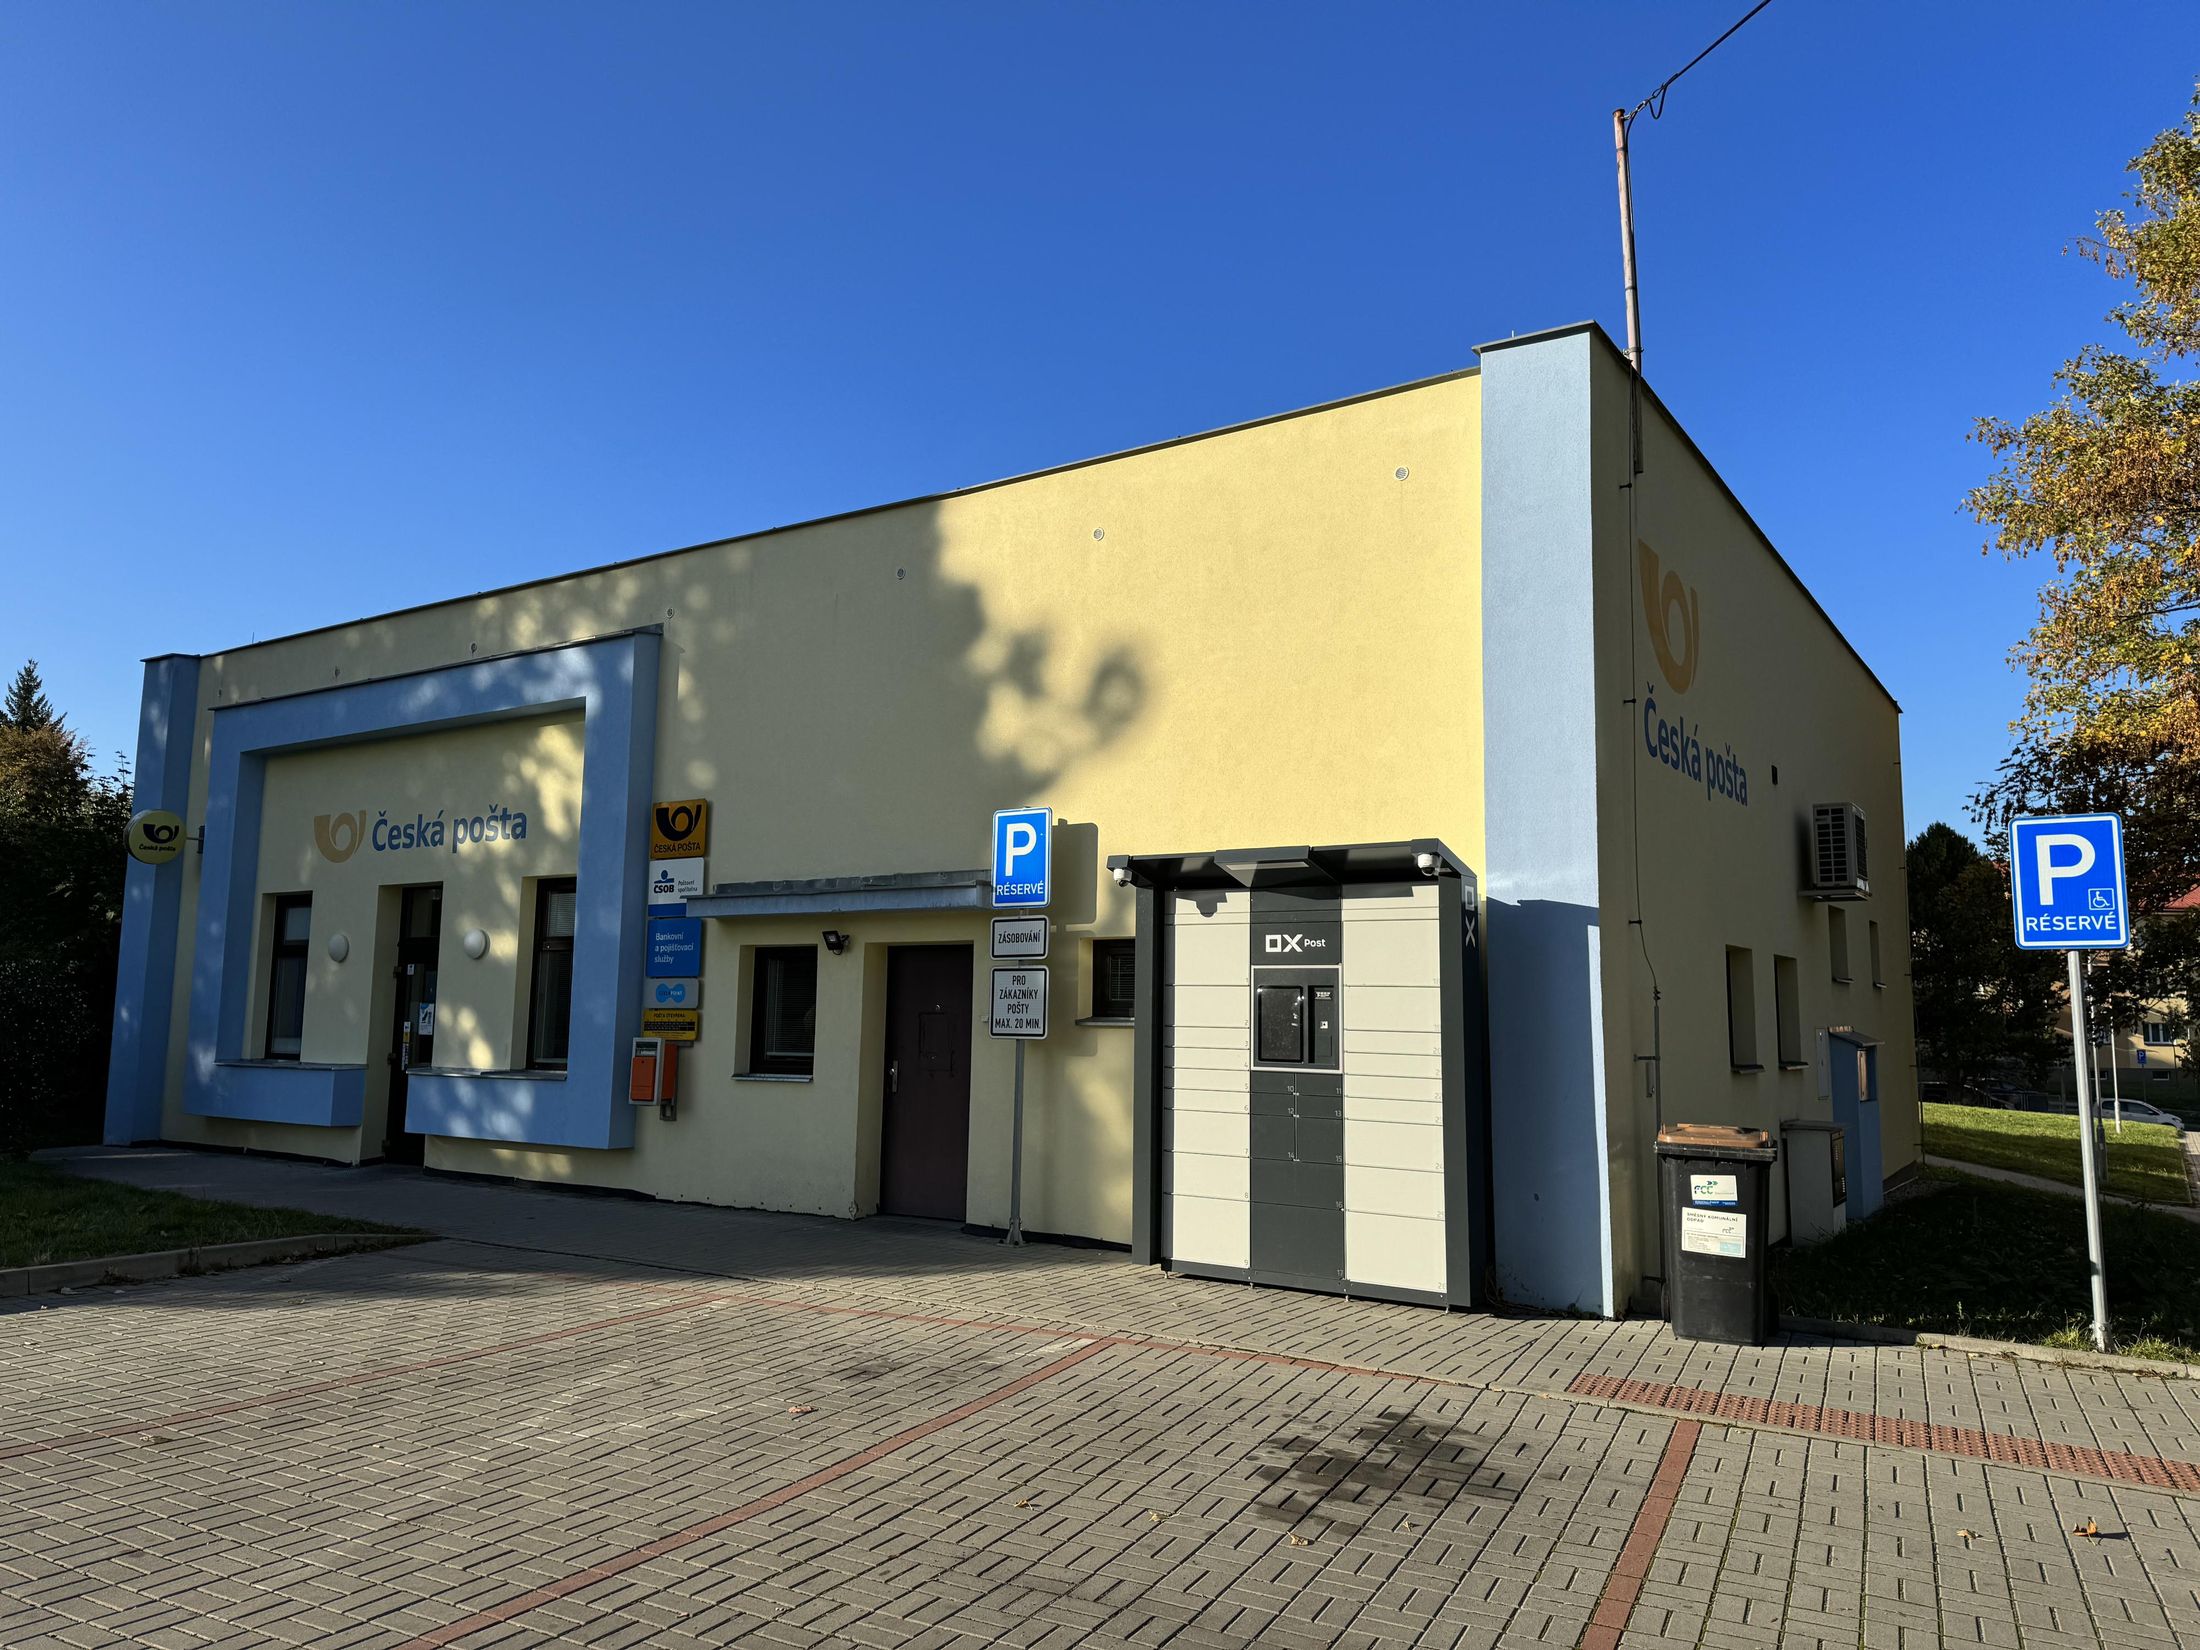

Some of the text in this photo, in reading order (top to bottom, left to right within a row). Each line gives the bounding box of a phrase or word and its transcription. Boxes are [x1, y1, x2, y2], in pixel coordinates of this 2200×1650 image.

[1644, 681, 1748, 807] Česká pošta
[372, 803, 527, 853] Česká pošta
[654, 840, 701, 854] ČESKÁ POŠTA
[1005, 822, 1037, 877] P
[2036, 833, 2096, 906] P
[653, 884, 675, 894] ČSOB
[996, 880, 1045, 896] RÉSERVÉ
[2026, 911, 2117, 932] RÉSERVÉ
[655, 931, 685, 941] Bankovní
[998, 929, 1041, 944] ZÁSOBOVÁNÍ
[660, 942, 694, 953] pojišťovací
[1304, 938, 1326, 948] Post
[654, 954, 674, 965] služby
[1012, 975, 1026, 986] PRO
[999, 987, 1038, 1000] ZÁKAZNÍKY
[1007, 1001, 1029, 1014] POŠTY
[995, 1018, 1041, 1029] MAX. 20 MIN.
[2139, 1051, 2144, 1060] P
